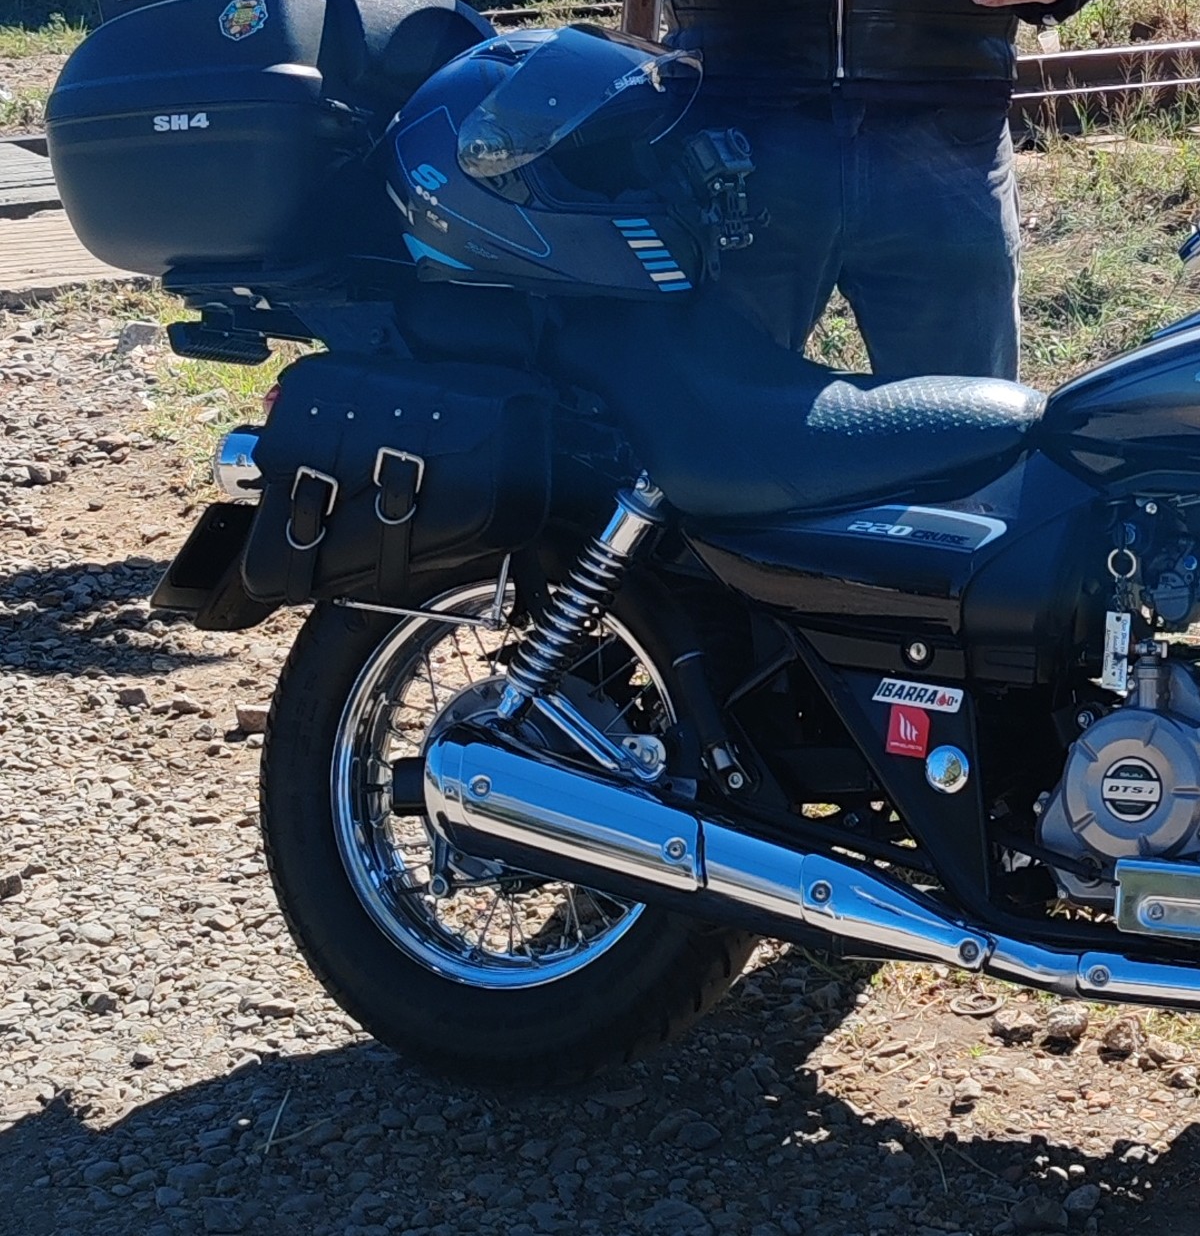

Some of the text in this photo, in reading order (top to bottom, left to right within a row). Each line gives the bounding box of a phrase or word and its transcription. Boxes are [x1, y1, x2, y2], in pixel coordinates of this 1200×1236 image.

[153, 112, 210, 132] SH4
[847, 520, 970, 544] 220 CRUISE
[876, 681, 939, 705] IBARRA
